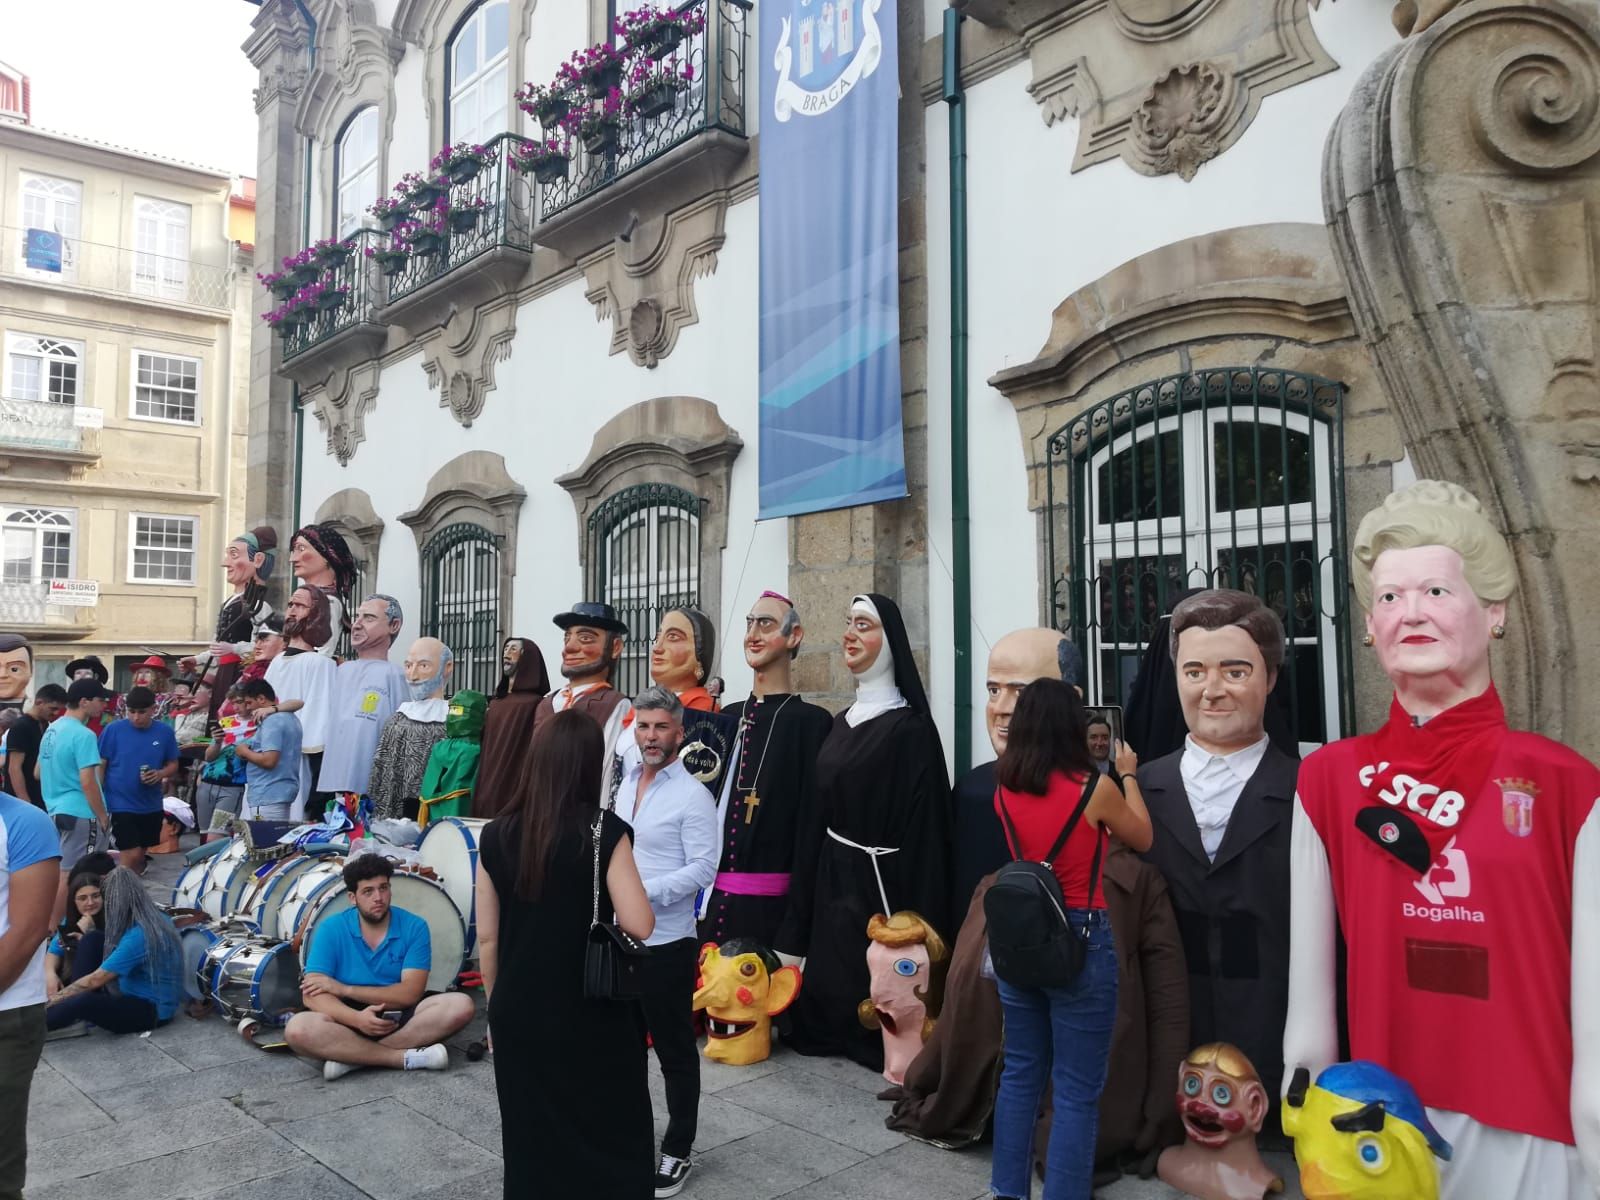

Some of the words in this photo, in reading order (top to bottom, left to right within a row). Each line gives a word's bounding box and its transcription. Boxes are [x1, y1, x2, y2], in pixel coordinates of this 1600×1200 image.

[802, 78, 851, 112] BRAGA
[67, 583, 96, 592] ISIDRO
[699, 759, 716, 769] volta
[1378, 773, 1465, 827] SCB
[1403, 902, 1485, 922] Bogalha
